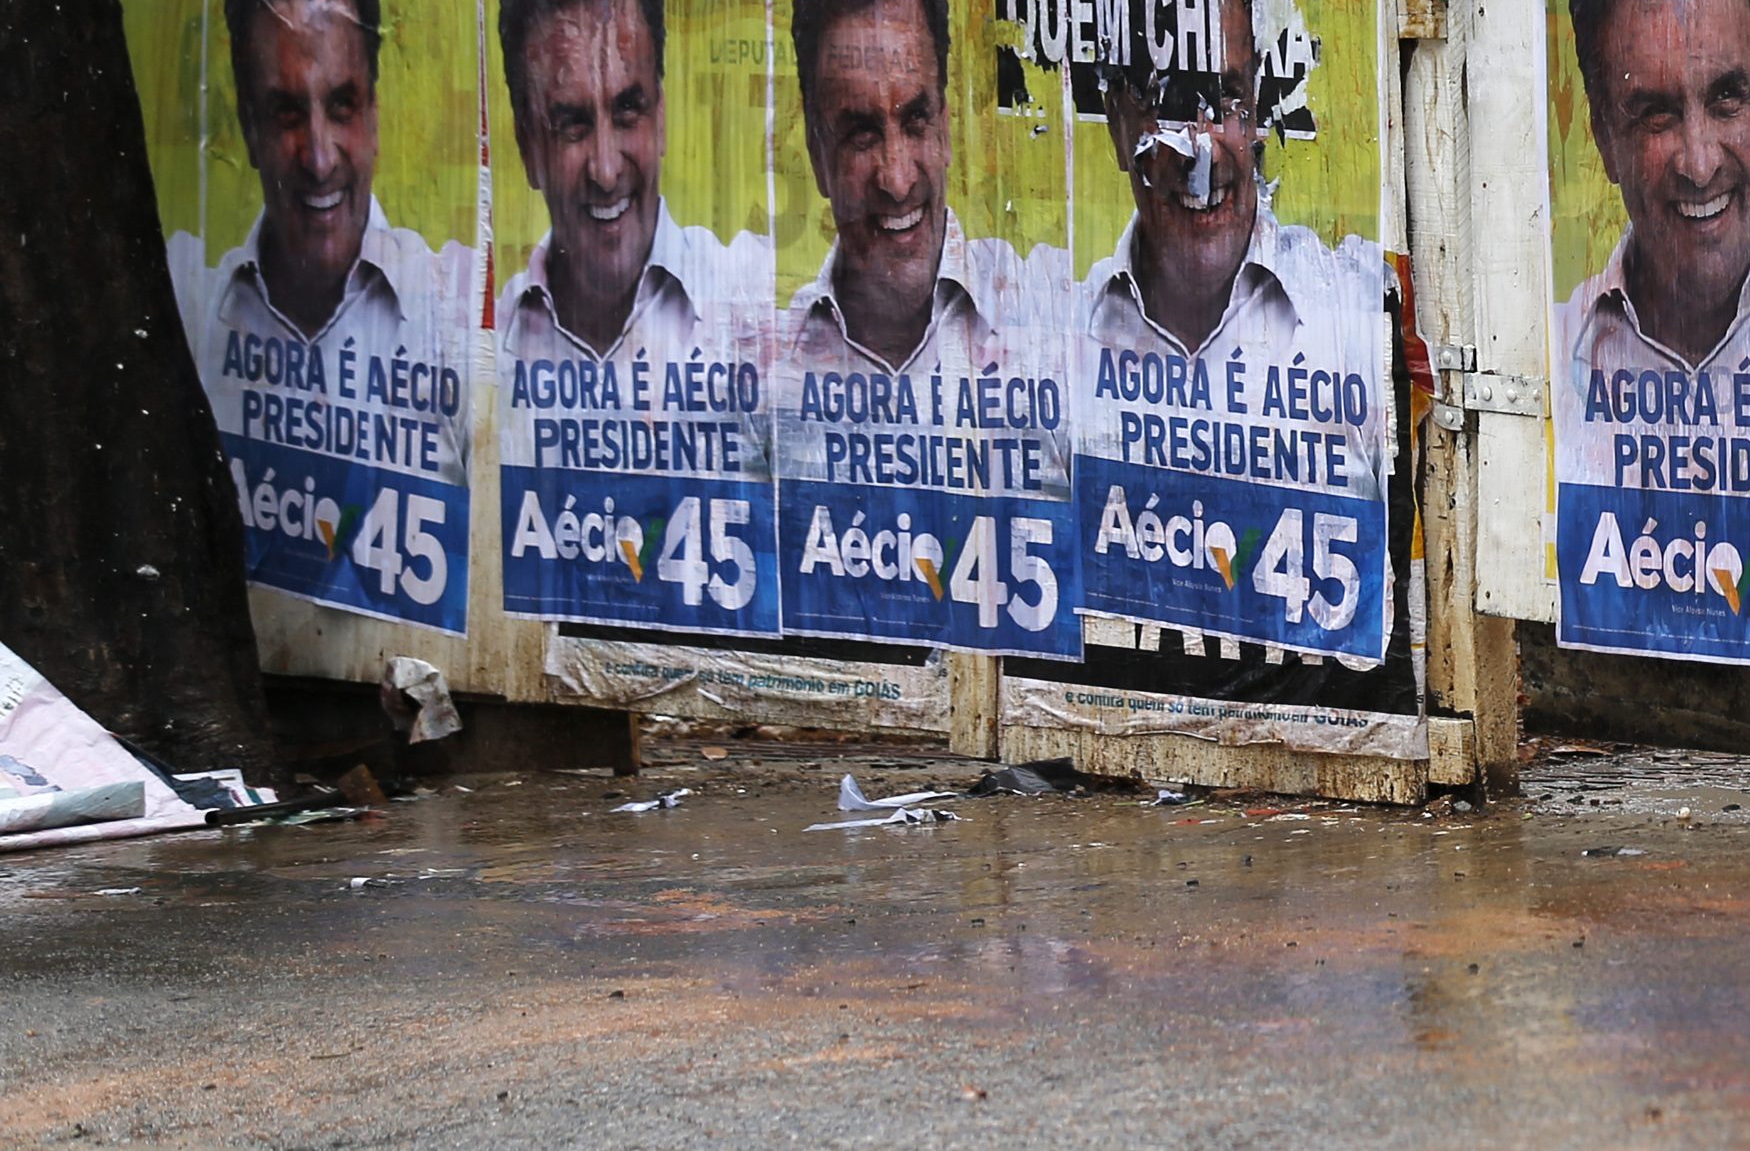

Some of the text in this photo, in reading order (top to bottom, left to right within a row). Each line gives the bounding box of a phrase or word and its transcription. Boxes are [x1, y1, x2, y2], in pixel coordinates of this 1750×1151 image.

[222, 330, 461, 418] AGORA É AÉCIO
[511, 346, 759, 413] AGORA É AÉCIO
[800, 361, 1061, 430] AGORA É AÉCIO
[1095, 345, 1368, 427] AGORA É AÉCIO
[1584, 368, 1719, 427] AGORA
[242, 389, 440, 472] PRESIDENTE
[533, 418, 742, 473] PRESIDENTE
[825, 432, 1043, 491] PRESIDENTE
[1120, 410, 1349, 488] PRESIDENTE
[352, 486, 448, 606] 45
[511, 490, 758, 611] Aécio 45
[799, 504, 1059, 633] Aécio 45
[1094, 484, 1361, 632] Aécio 45
[1579, 511, 1744, 598] Aécio
[748, 673, 825, 693] patrimônio
[828, 681, 852, 695] em
[854, 678, 902, 701] GOIÁS
